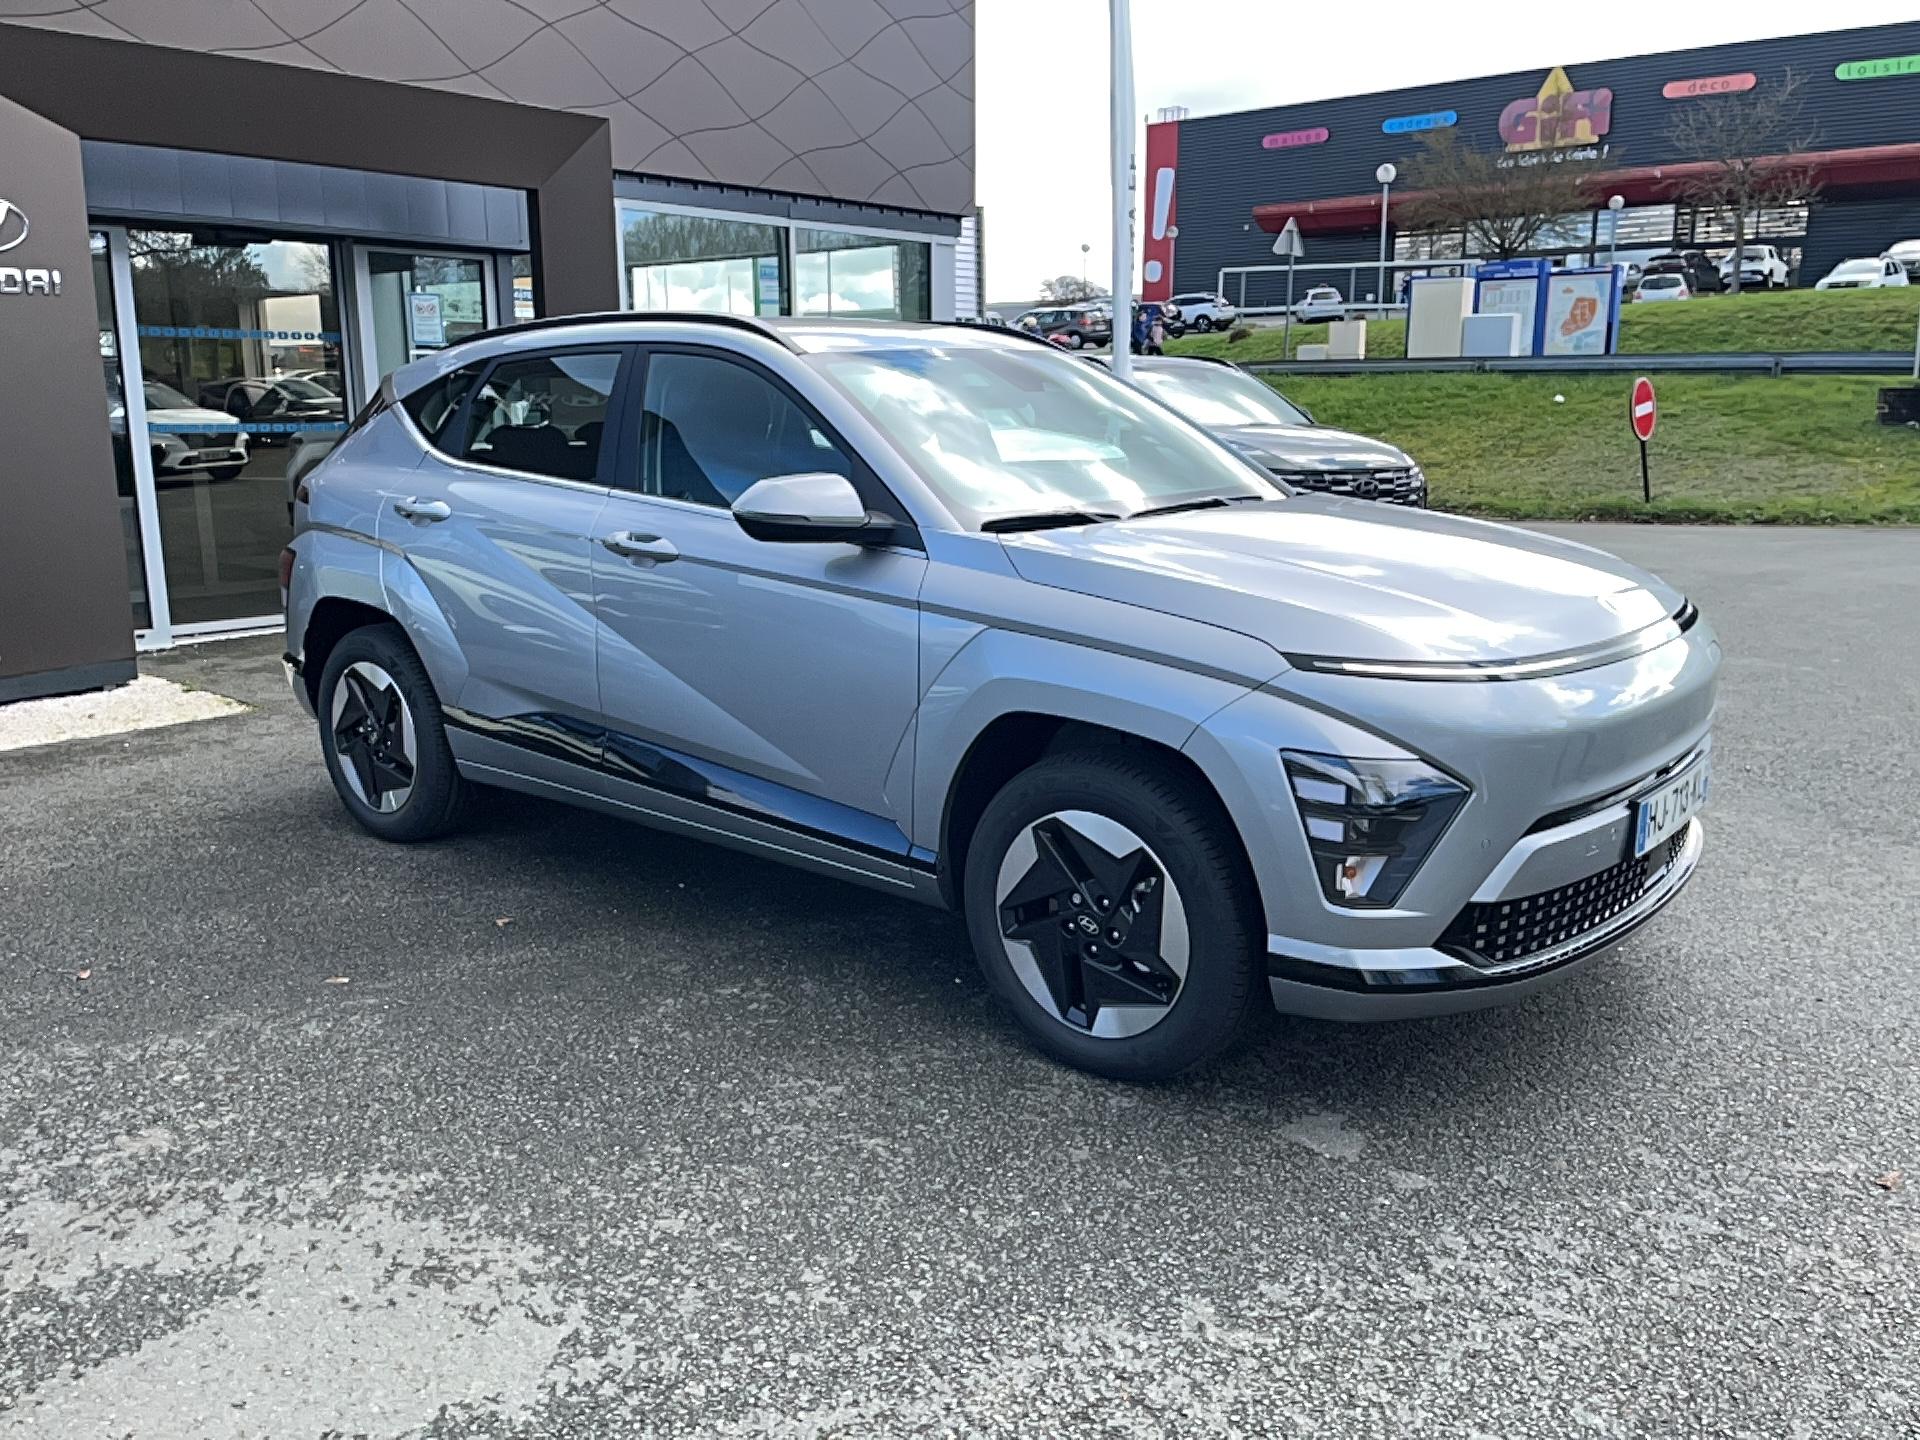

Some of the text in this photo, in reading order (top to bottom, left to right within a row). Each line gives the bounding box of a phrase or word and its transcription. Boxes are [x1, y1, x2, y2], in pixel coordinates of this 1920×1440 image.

[1847, 60, 1915, 77] loisir
[1687, 80, 1730, 94] déco
[1269, 132, 1321, 146] maison
